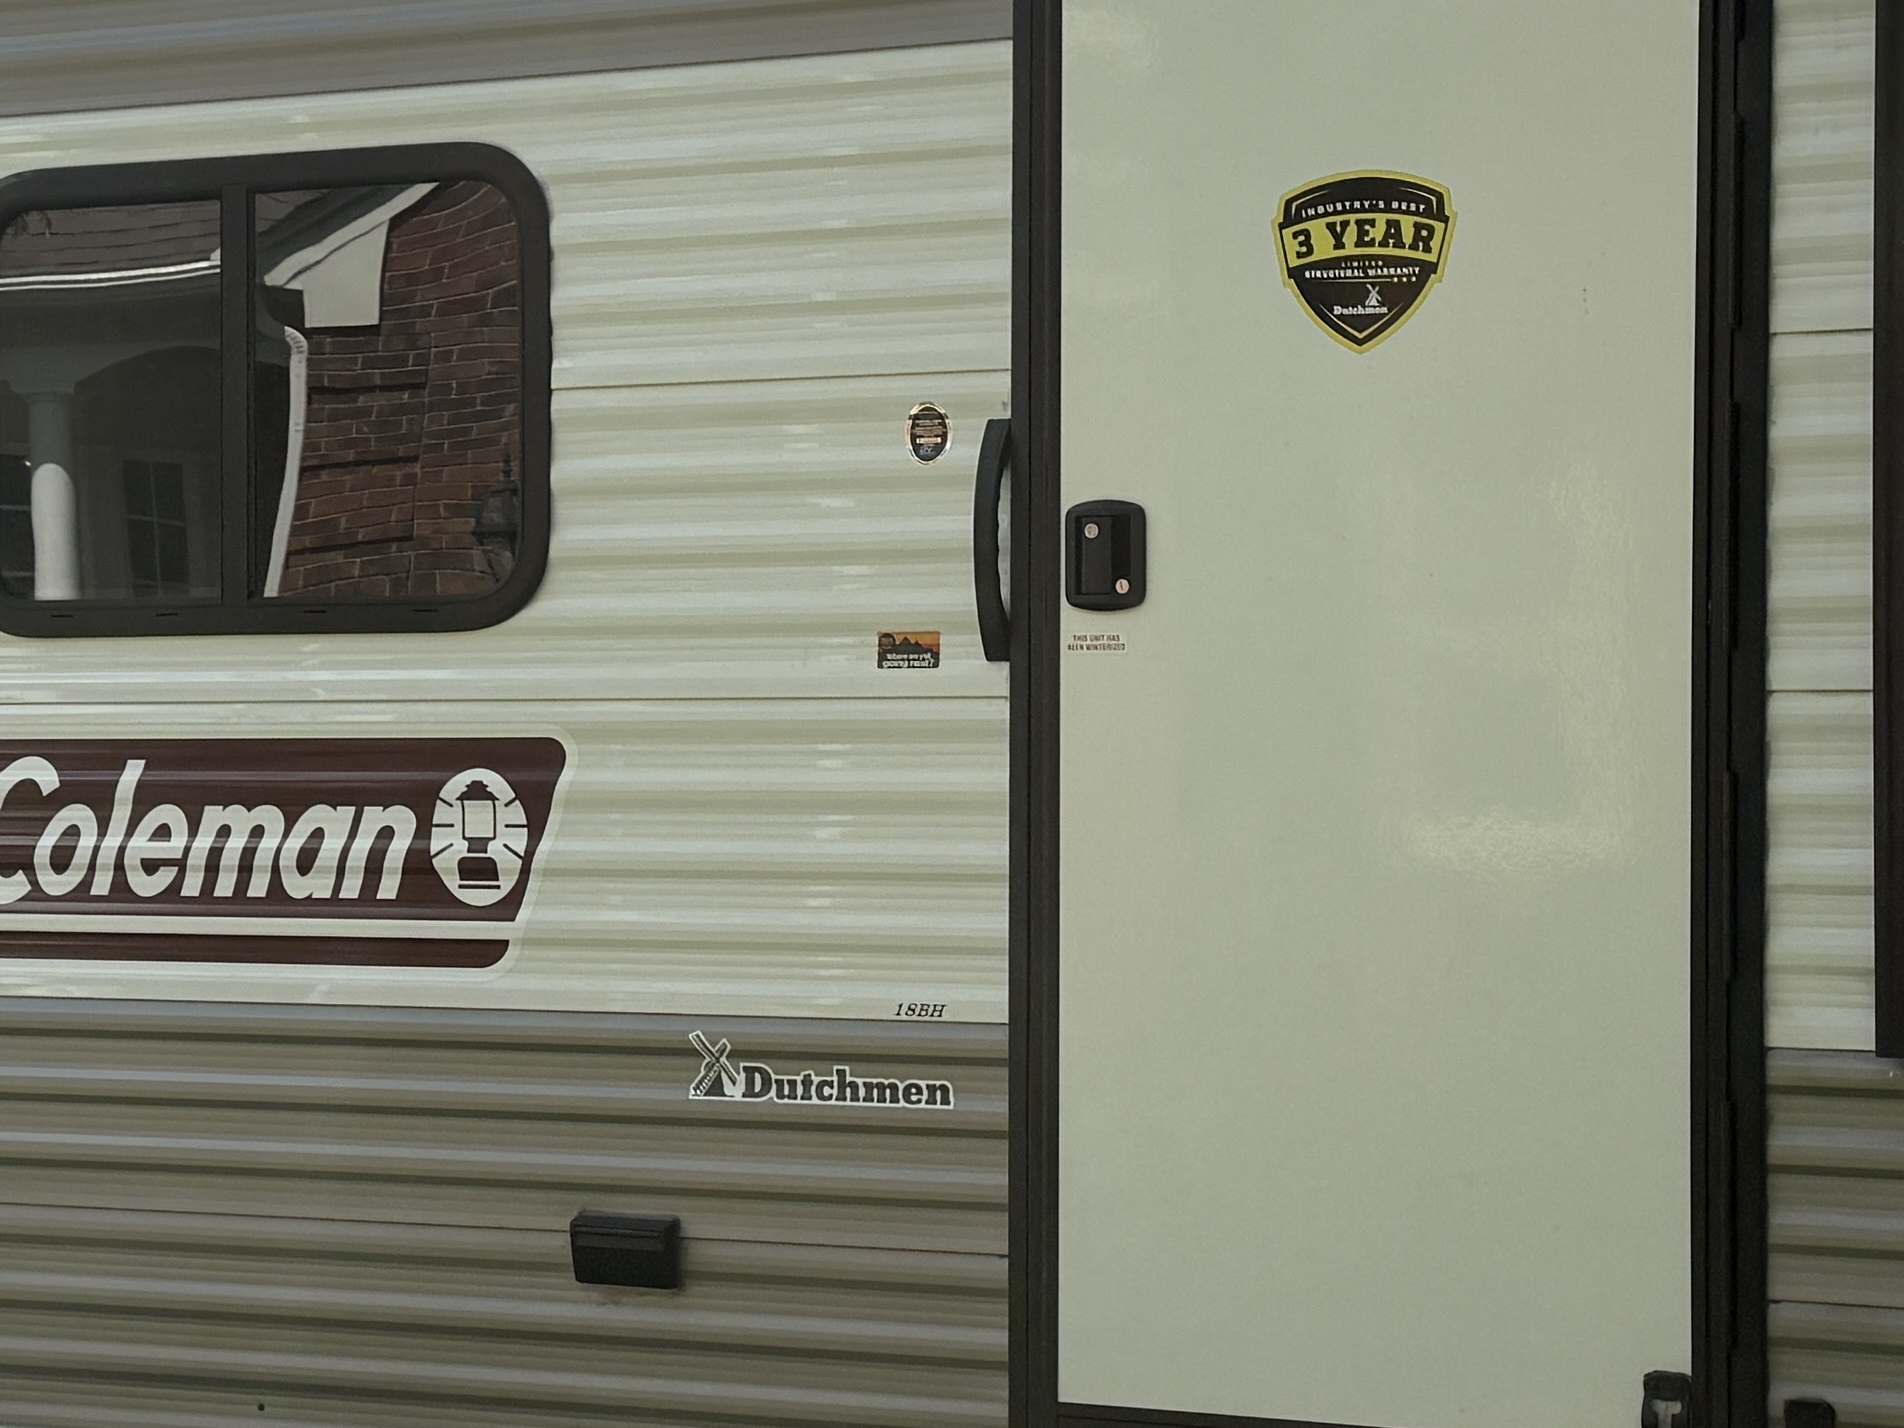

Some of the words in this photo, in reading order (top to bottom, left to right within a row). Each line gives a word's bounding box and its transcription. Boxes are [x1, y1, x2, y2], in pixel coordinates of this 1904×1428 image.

[1291, 227, 1315, 260] 3
[1324, 217, 1437, 254] YEAR
[894, 1002, 947, 1018] 18BH
[740, 1063, 953, 1108] Dutchmen
